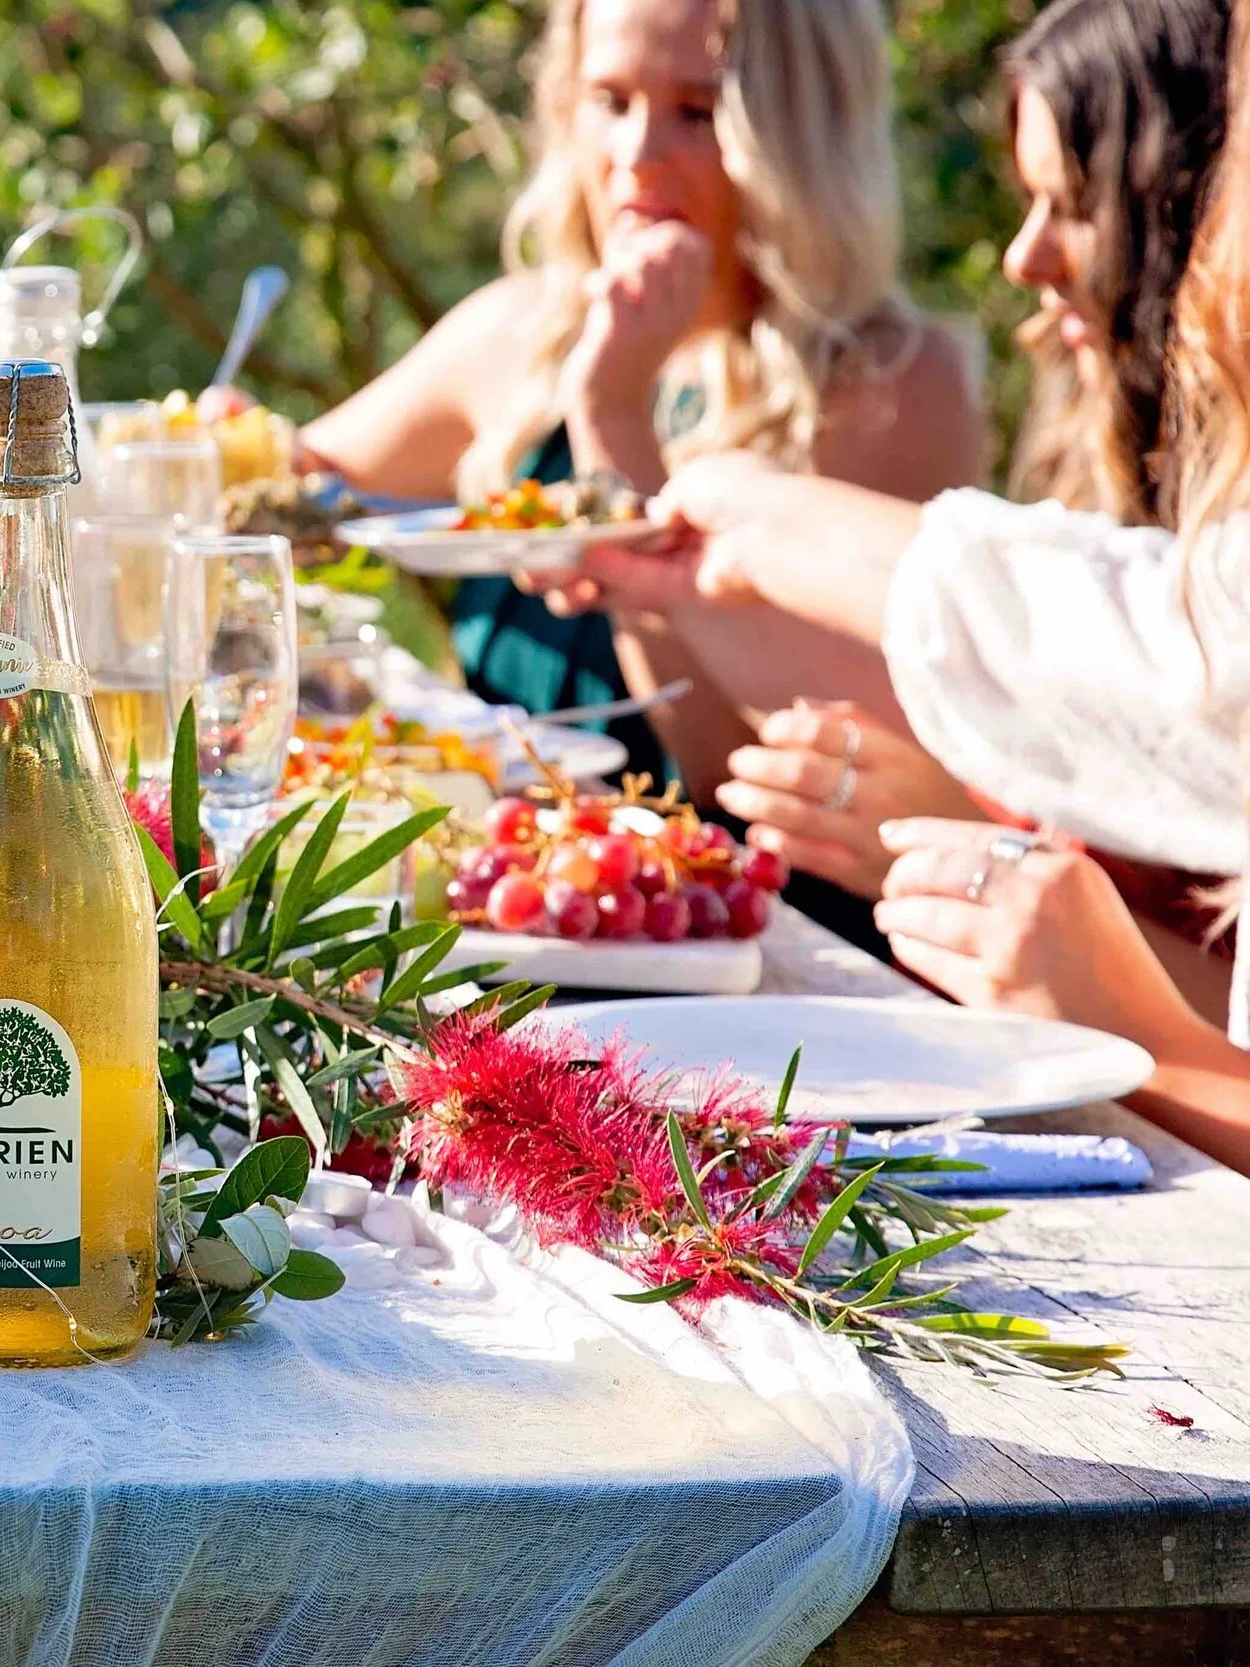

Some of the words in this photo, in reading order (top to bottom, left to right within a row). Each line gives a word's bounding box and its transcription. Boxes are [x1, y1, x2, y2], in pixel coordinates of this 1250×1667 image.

[3, 683, 26, 694] WINERY
[6, 1168, 57, 1181] winery
[21, 1259, 41, 1269] Fruit
[43, 1258, 66, 1269] Wine
